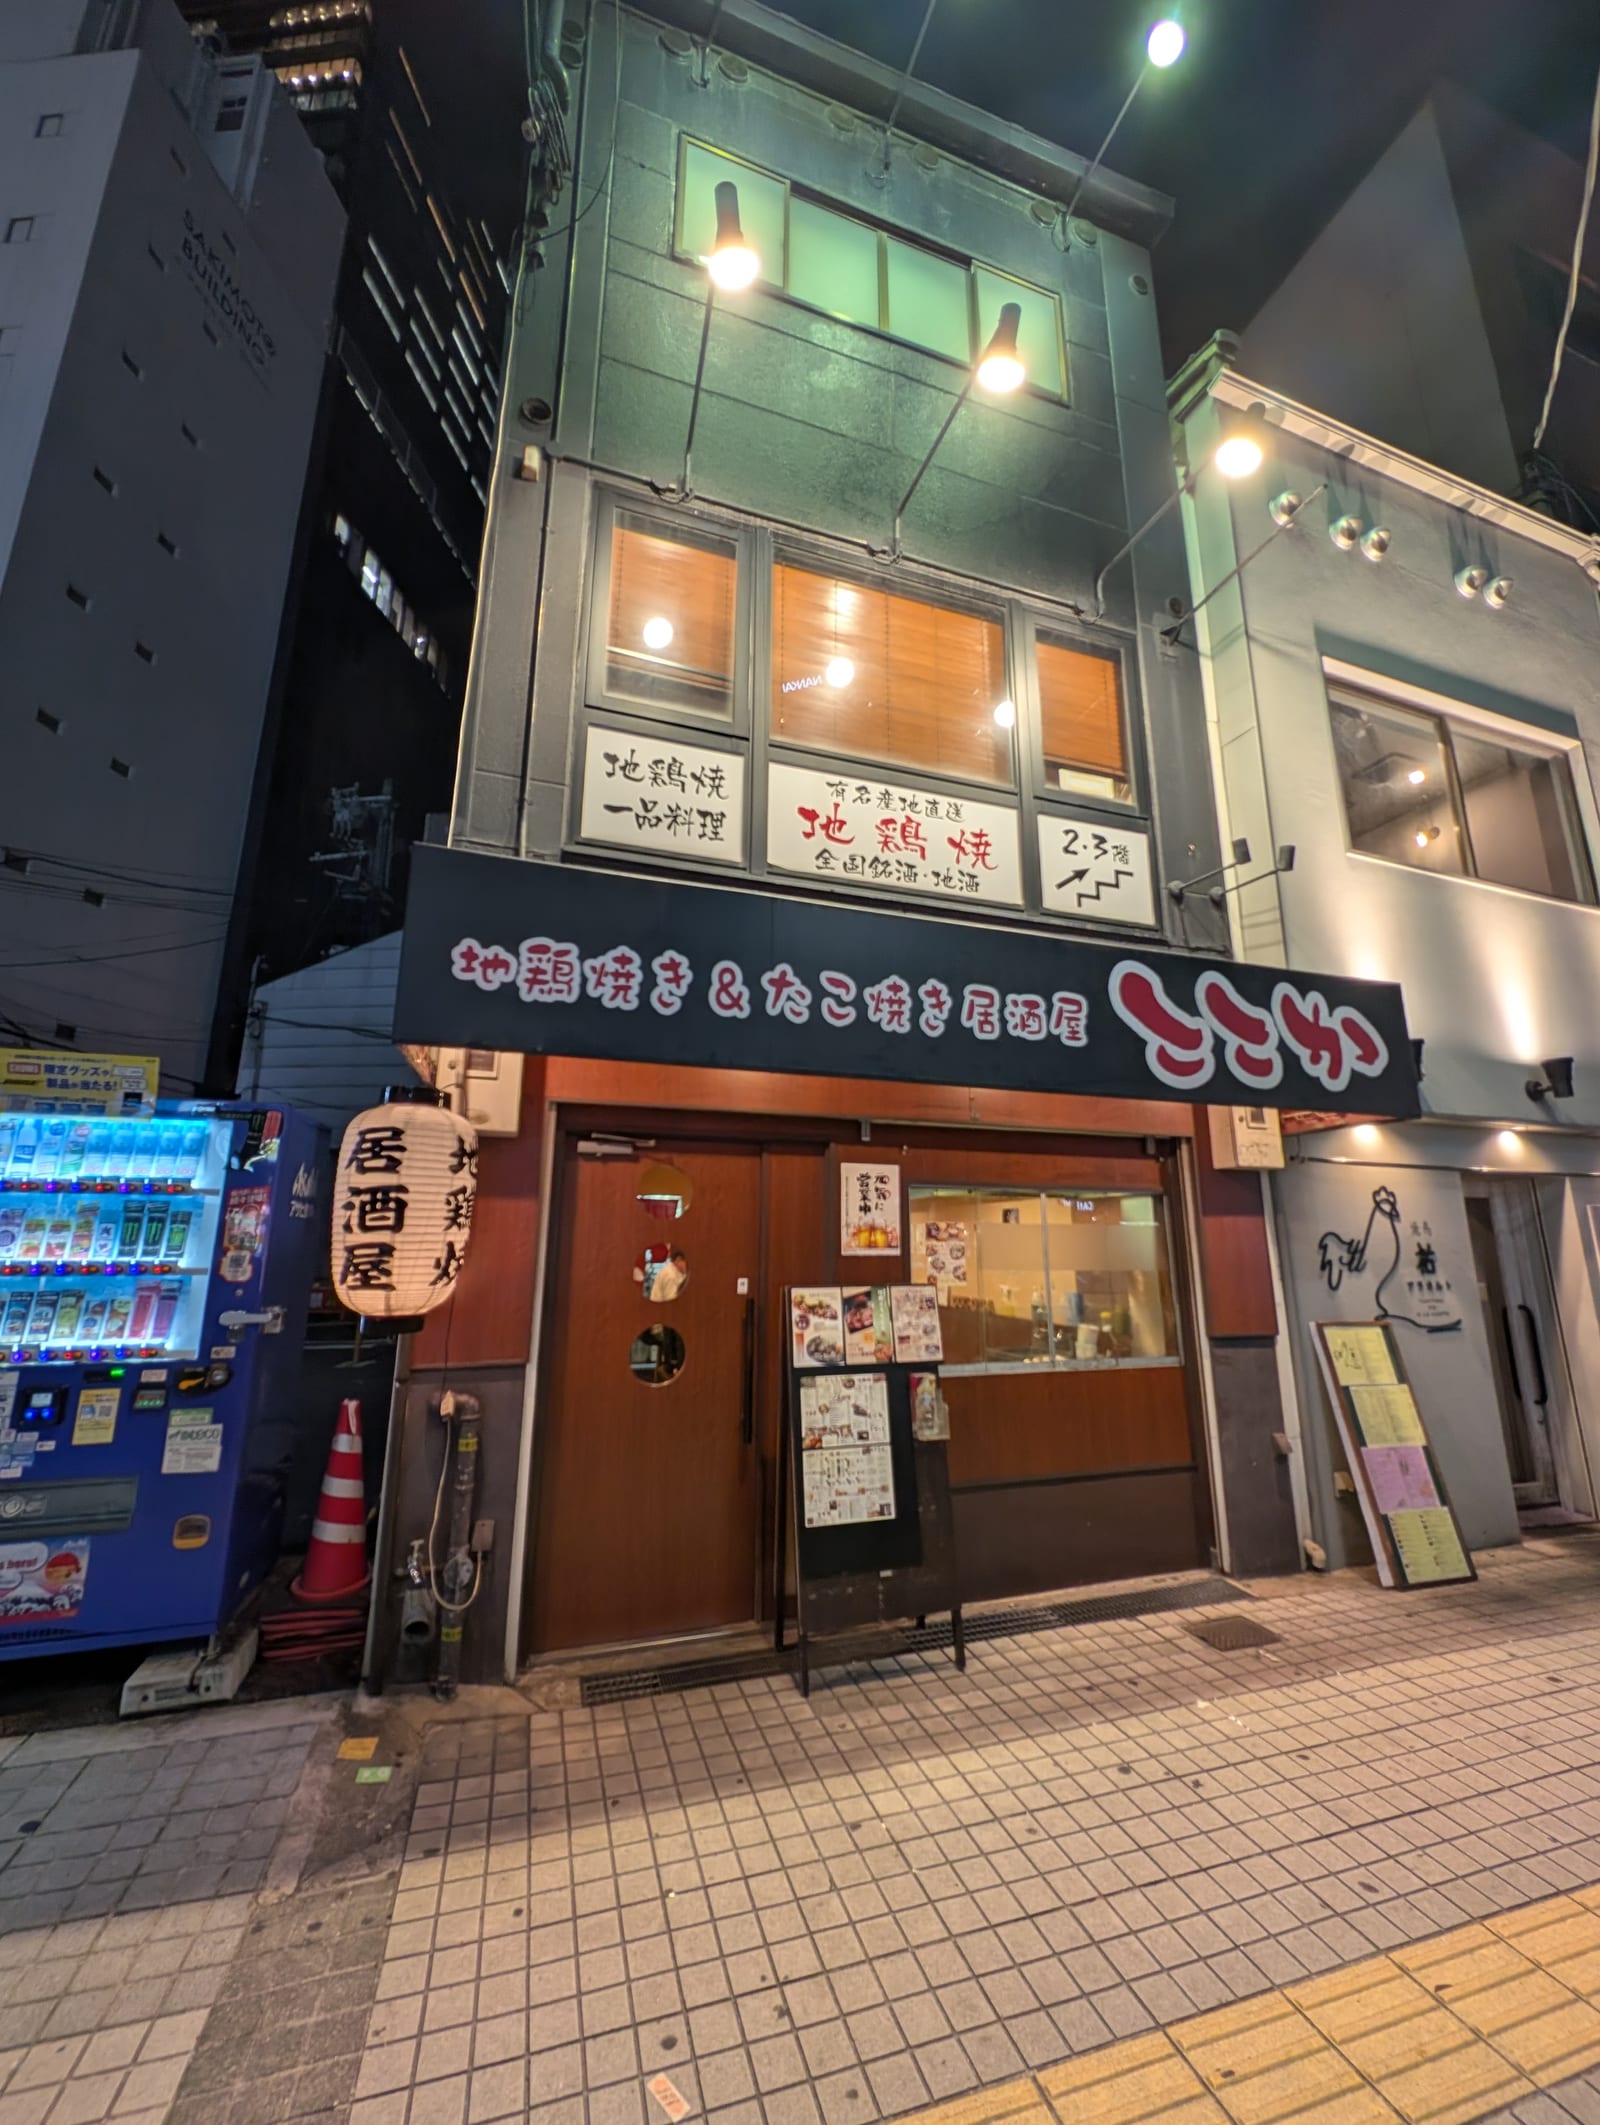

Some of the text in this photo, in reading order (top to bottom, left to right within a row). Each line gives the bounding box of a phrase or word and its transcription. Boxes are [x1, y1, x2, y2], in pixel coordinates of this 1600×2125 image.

[182, 236, 265, 366] BUILDING
[602, 748, 729, 800] 地鶏焼
[602, 796, 727, 842] 一品料理
[825, 780, 965, 824] 有名産地直送
[339, 1126, 410, 1292] 居酒屋
[857, 1171, 872, 1216] 営業中
